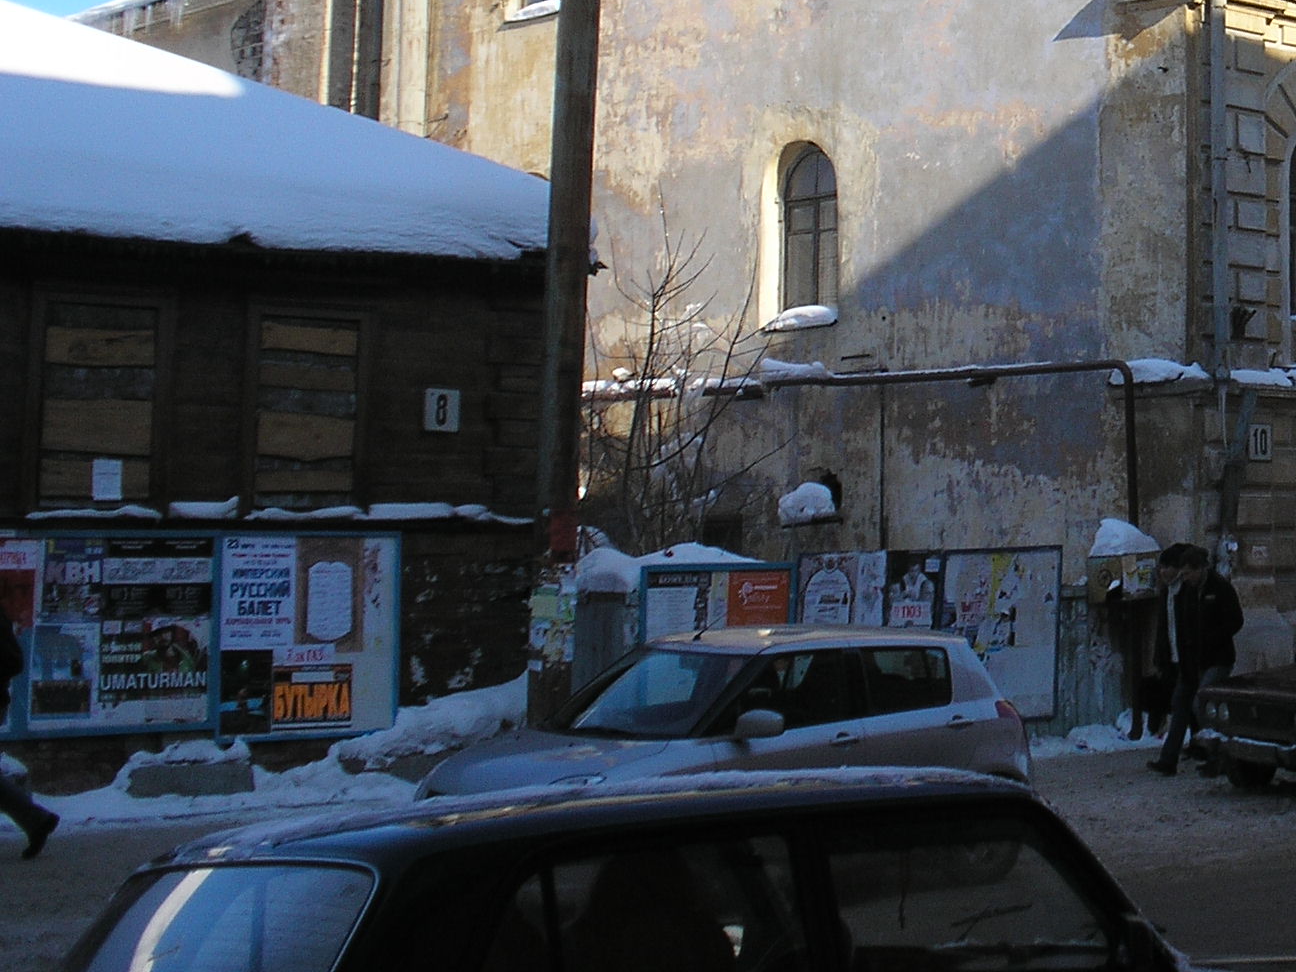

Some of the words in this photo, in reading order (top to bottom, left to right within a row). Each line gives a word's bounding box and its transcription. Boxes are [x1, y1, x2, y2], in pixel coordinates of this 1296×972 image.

[436, 394, 448, 427] 8
[1253, 428, 1268, 455] 10
[46, 560, 103, 585] КВН
[229, 580, 291, 599] РУССКИЙ
[237, 600, 283, 616] БАЛЕТ
[101, 671, 207, 691] UMATURMAN
[274, 682, 350, 721] БУТЫРКА
